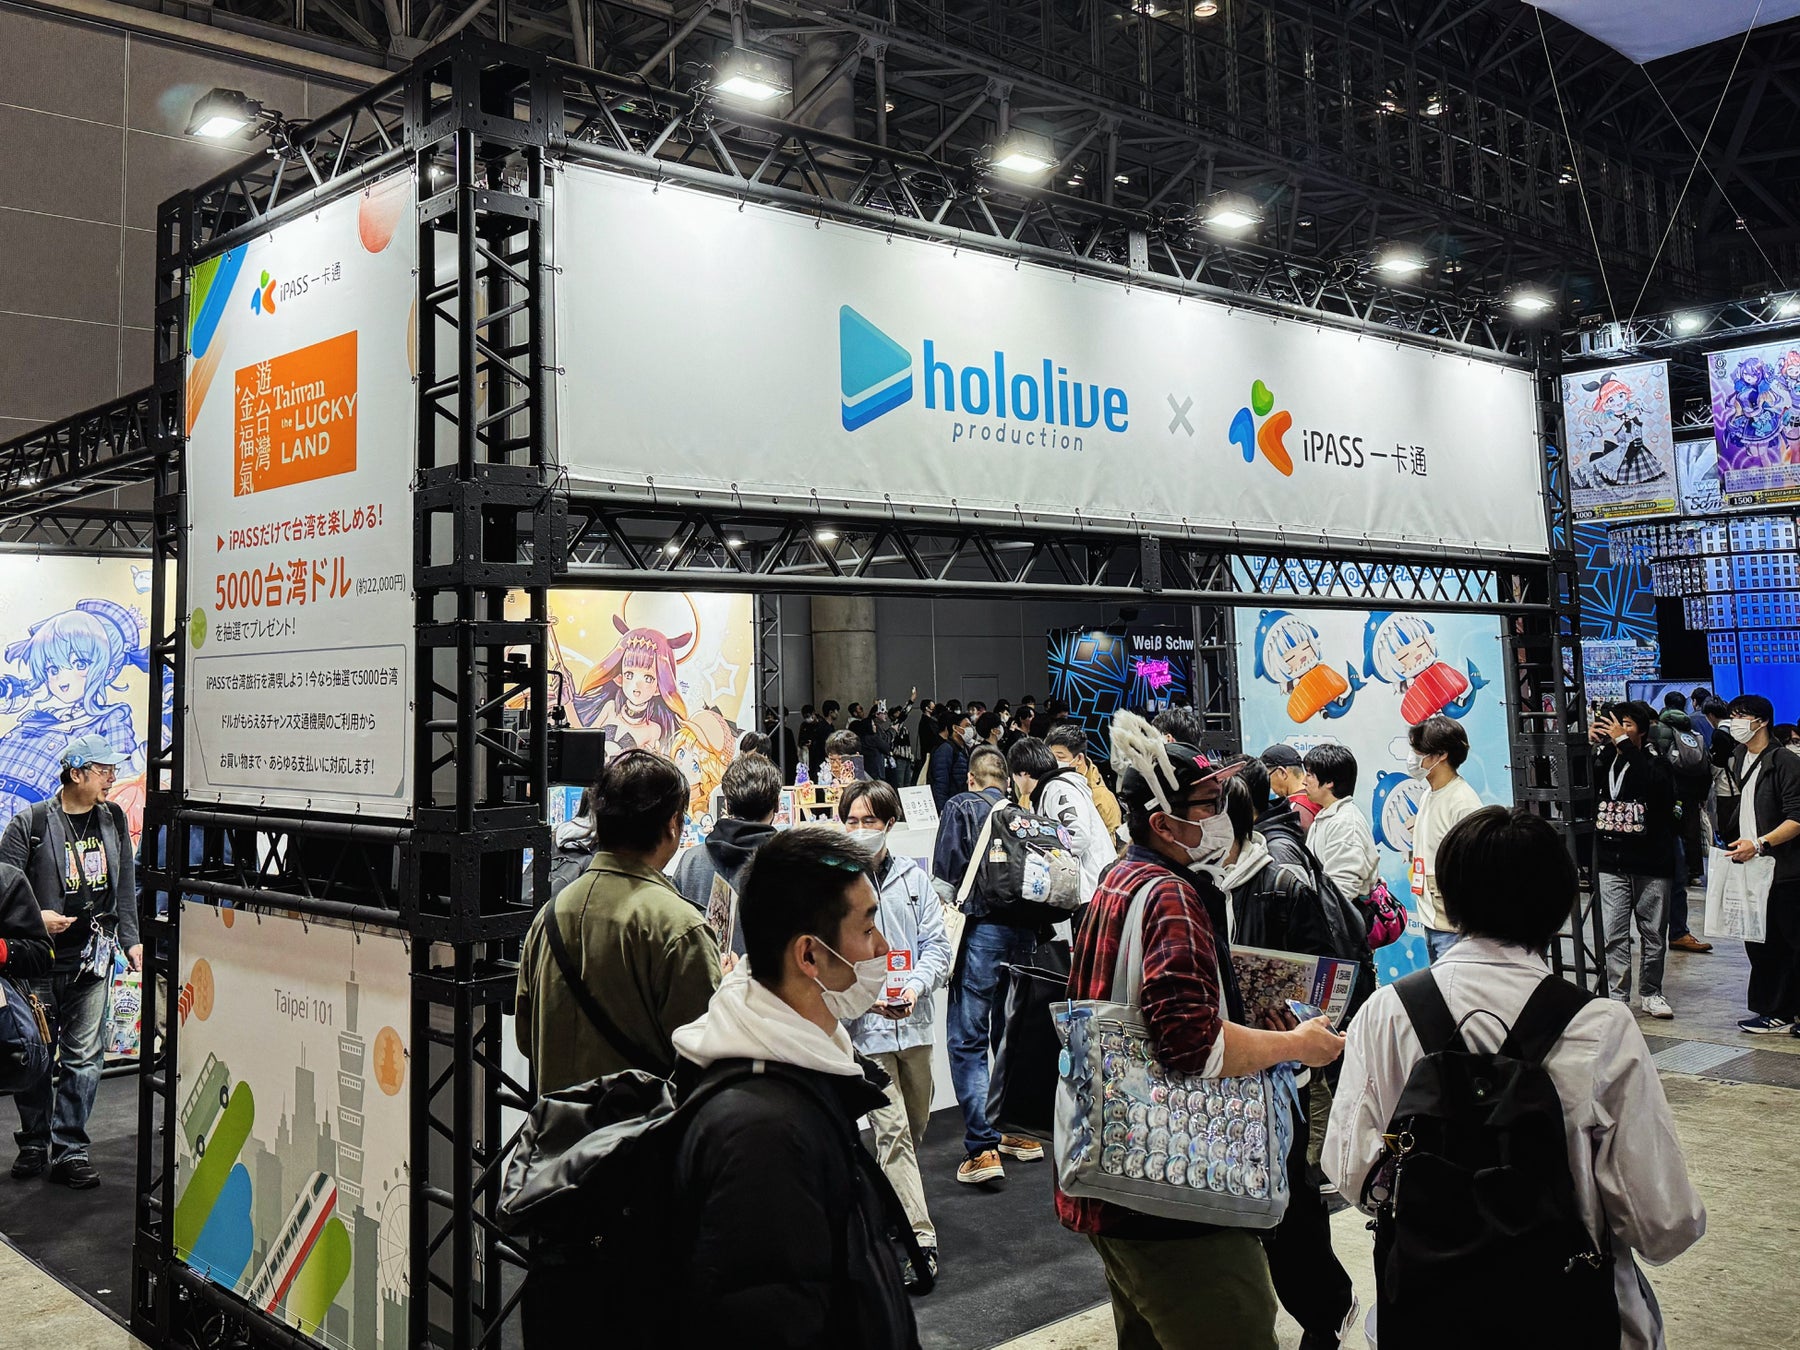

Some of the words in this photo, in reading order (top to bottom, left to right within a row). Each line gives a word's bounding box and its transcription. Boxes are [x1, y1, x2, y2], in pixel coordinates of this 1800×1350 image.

[280, 275, 308, 302] iPASS
[311, 262, 341, 285] 一卡通
[273, 380, 326, 410] Taiwan
[923, 338, 1129, 433] hololive
[255, 360, 272, 471] 遊台灣
[281, 418, 293, 429] the
[295, 393, 358, 431] LUCKY
[239, 386, 255, 495] 金福氣
[281, 431, 330, 464] LAND
[952, 421, 1083, 451] production
[1303, 429, 1364, 468] iPASS
[1370, 443, 1427, 476] 一卡通
[1575, 511, 1593, 519] 1000
[1733, 496, 1753, 505] 1500
[229, 504, 383, 551] iPASSだけで台湾を楽しめる!
[215, 556, 352, 611] 5000台湾ドル
[355, 573, 406, 597] (約22,000円)
[1132, 635, 1162, 651] Weiß
[274, 988, 309, 1022] Taipei
[313, 999, 332, 1026] 101
